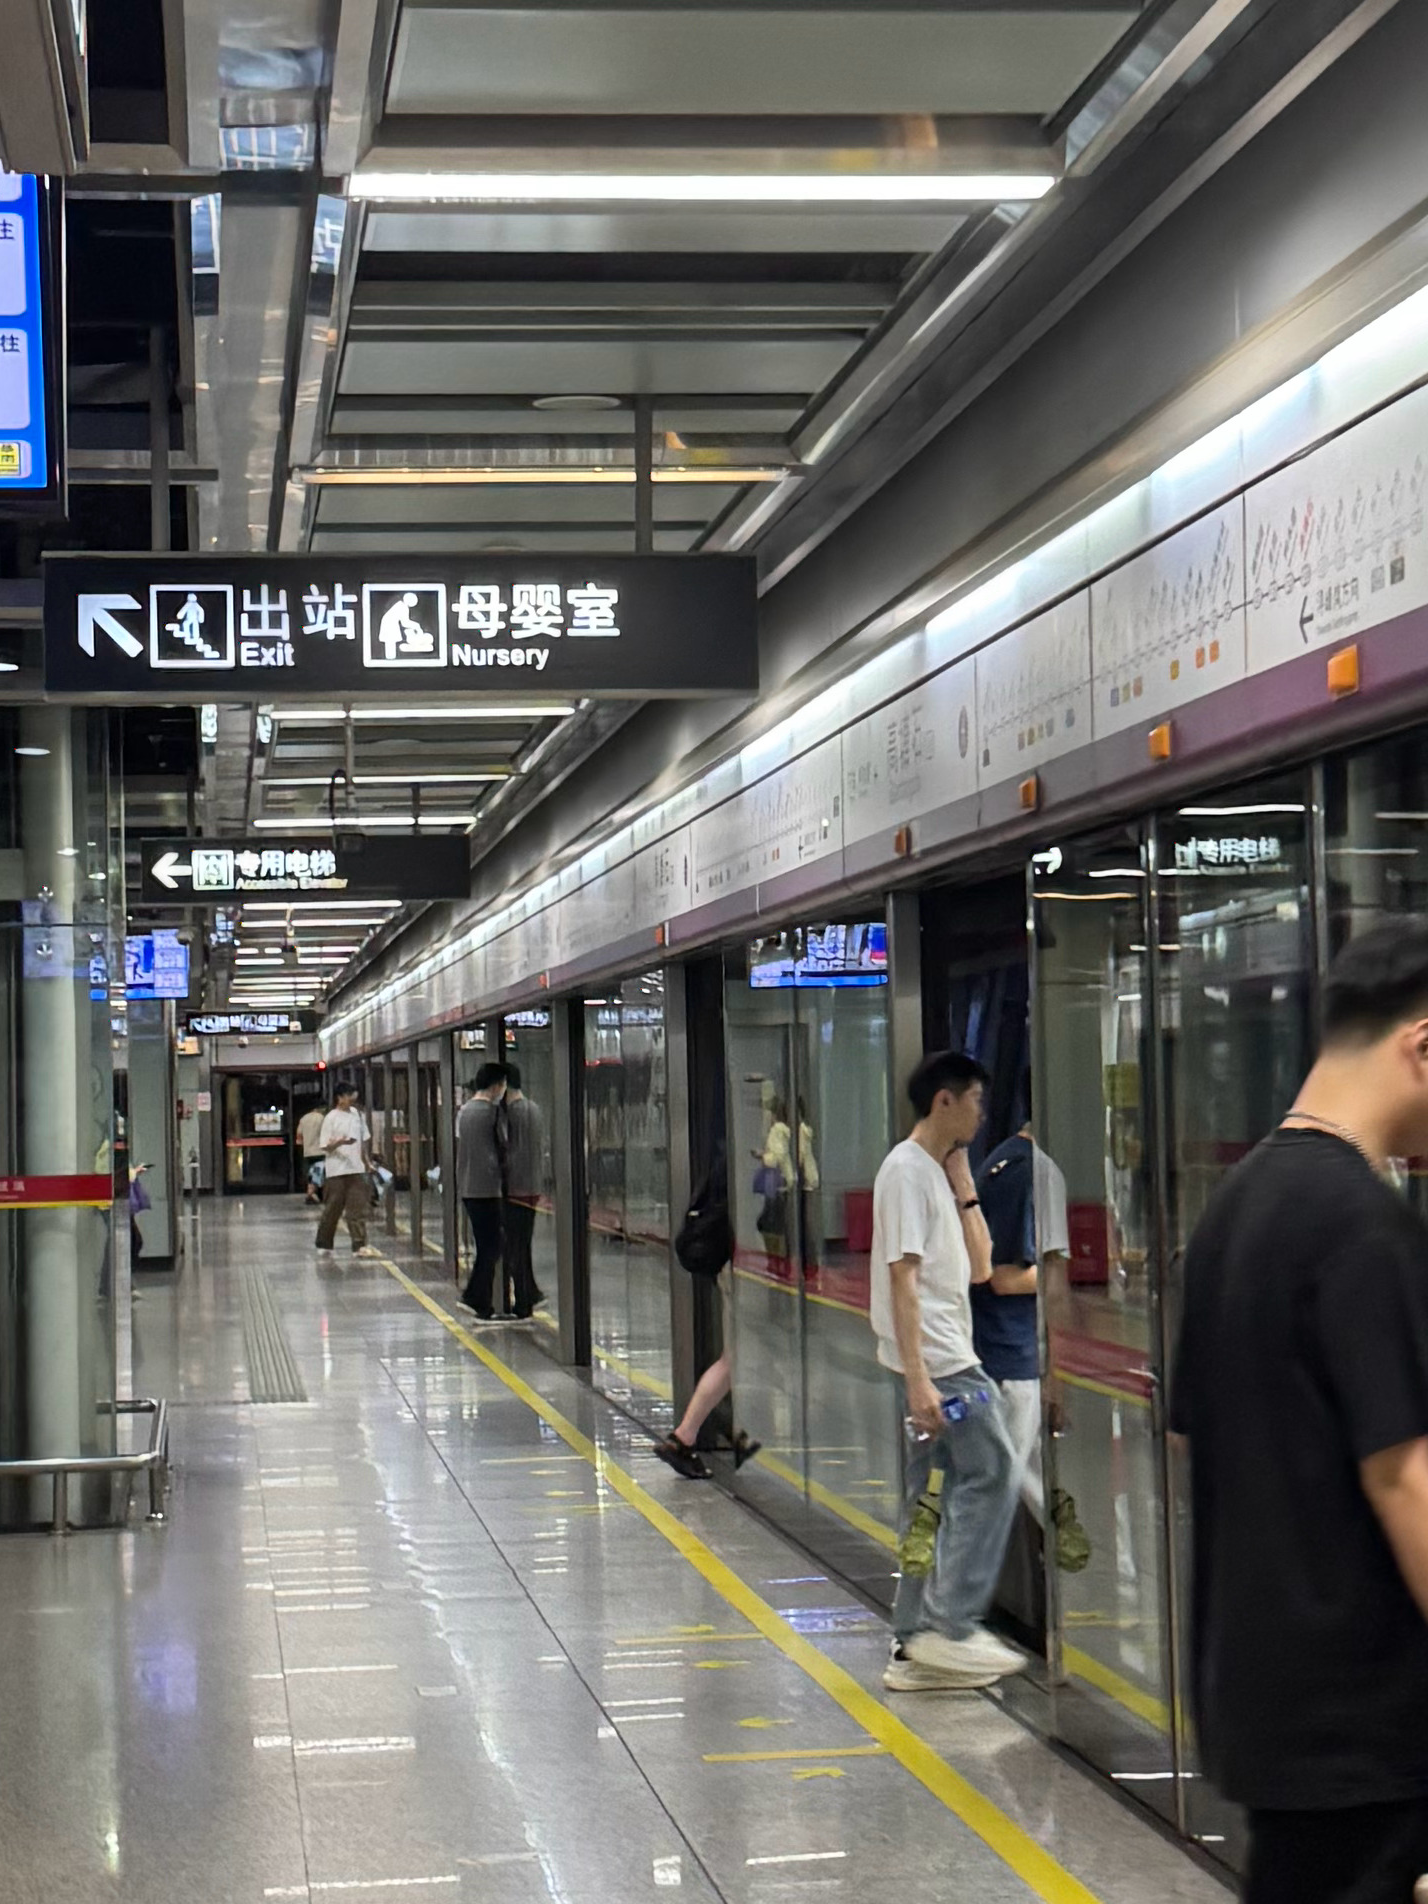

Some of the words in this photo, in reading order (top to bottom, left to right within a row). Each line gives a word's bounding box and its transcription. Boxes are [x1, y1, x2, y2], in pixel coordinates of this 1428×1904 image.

[239, 583, 358, 640] 出站
[451, 584, 622, 639] 母婴室
[239, 641, 295, 667] Exit
[452, 644, 550, 670] Nursery
[235, 850, 337, 878] 专用电梯
